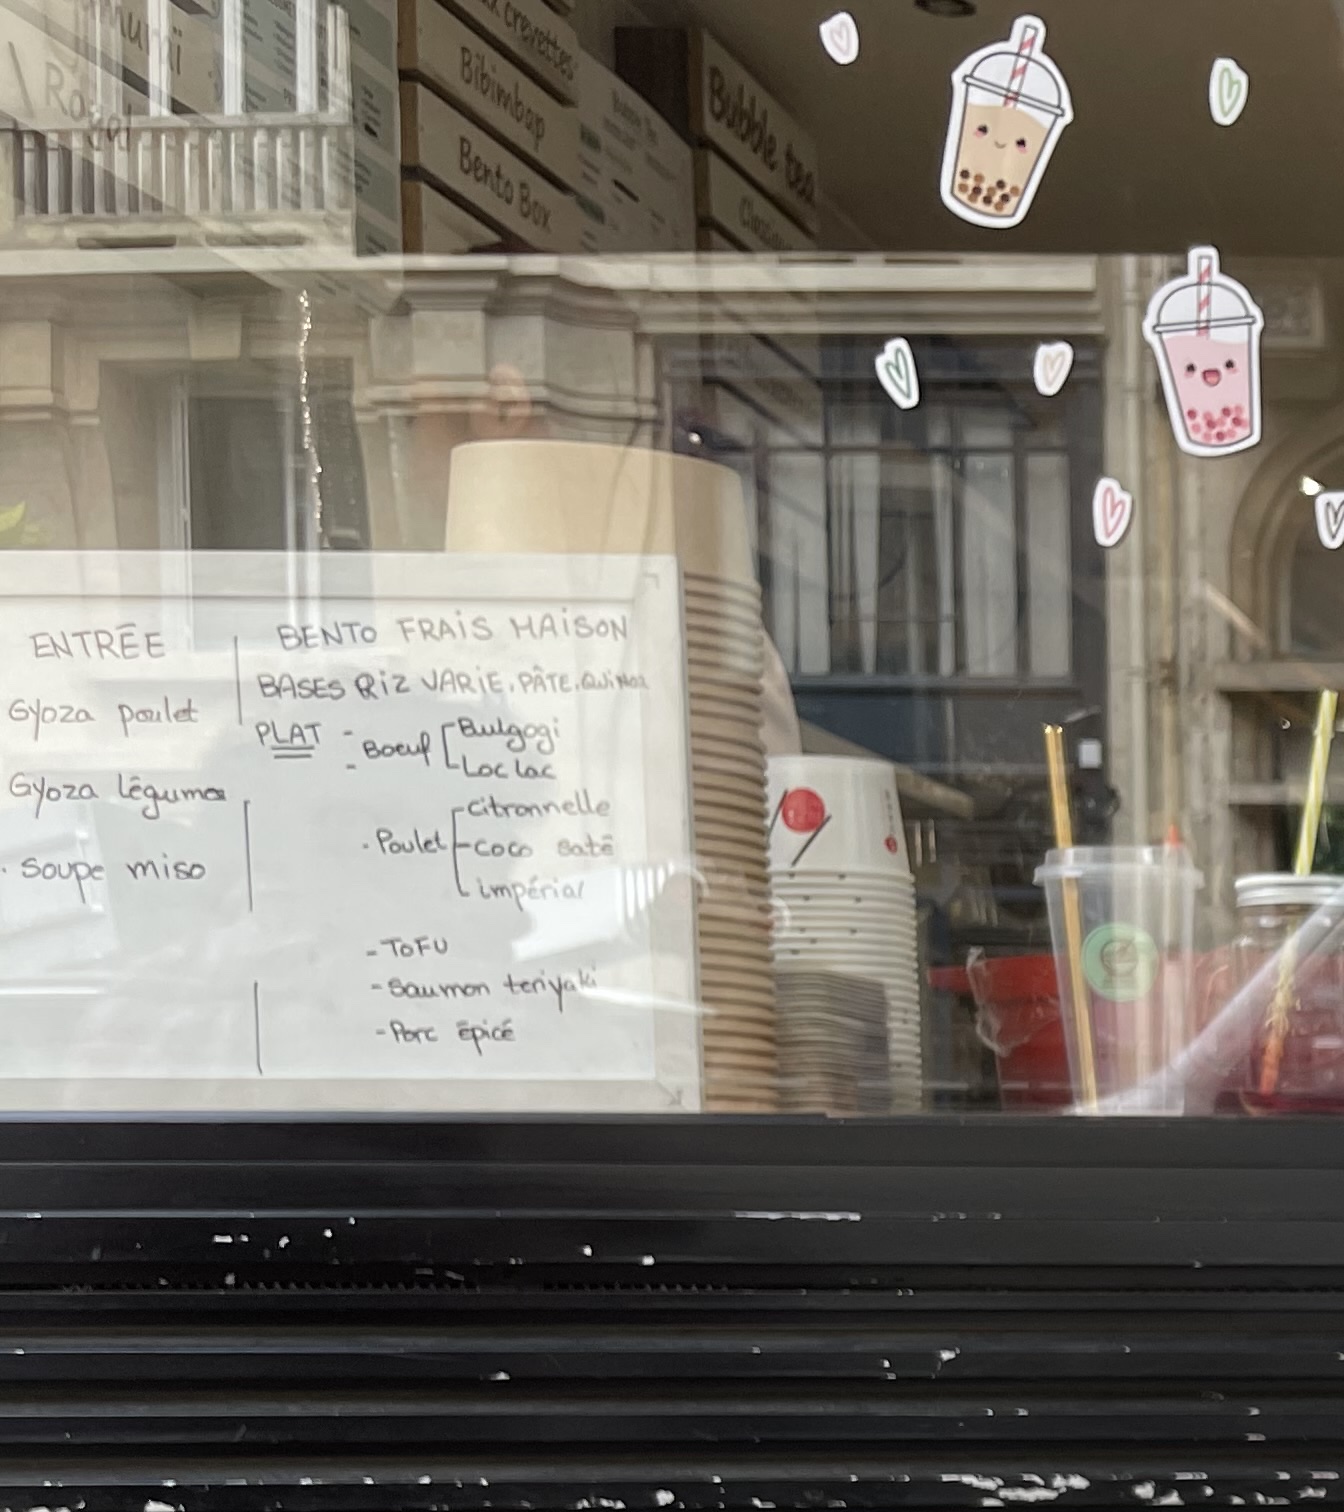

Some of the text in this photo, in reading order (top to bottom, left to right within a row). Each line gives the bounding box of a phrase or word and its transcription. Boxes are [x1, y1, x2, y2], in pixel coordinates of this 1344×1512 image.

[460, 46, 545, 152] Bibimbap
[708, 65, 778, 172] Bubble
[459, 135, 551, 230] Bento Box
[29, 622, 166, 660] ENTRÉE
[276, 620, 378, 652] BENTO
[257, 672, 347, 701] BASES
[8, 698, 96, 742] Gyoza
[255, 721, 322, 746] PLAT
[457, 716, 561, 755] Bulgogi
[462, 756, 509, 780] Loc
[9, 772, 98, 820] Gyoza
[376, 828, 448, 856] Poulet
[21, 851, 207, 906] Soupe miso
[476, 874, 585, 912] impérial
[389, 1018, 438, 1044] Porc
